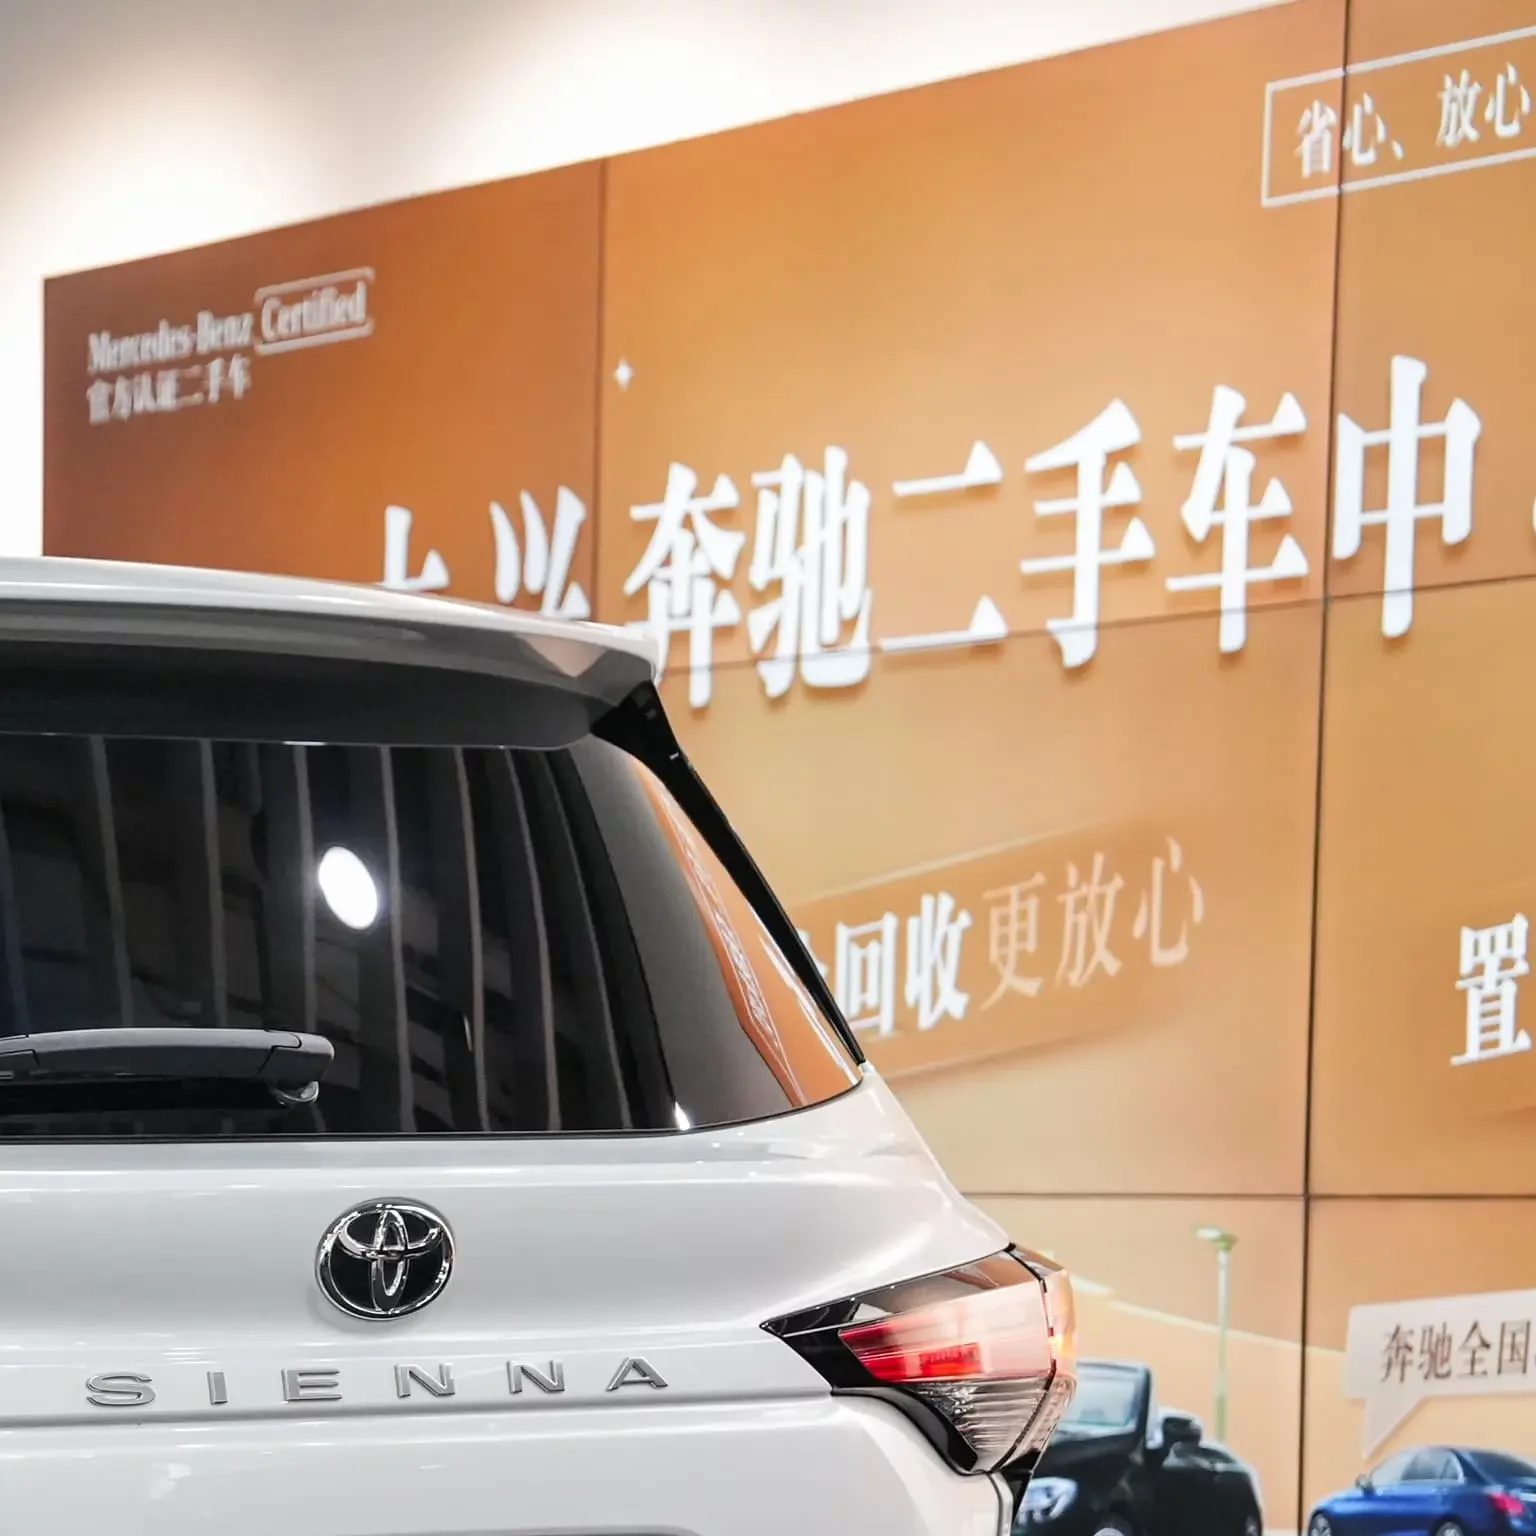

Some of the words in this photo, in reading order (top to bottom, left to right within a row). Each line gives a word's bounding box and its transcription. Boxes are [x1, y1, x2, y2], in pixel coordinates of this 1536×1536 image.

[87, 309, 254, 376] Mercedes-Benz
[260, 279, 368, 343] Certified
[86, 353, 253, 426] 官方认证二手车
[797, 836, 1205, 1037] 回收更放心
[1449, 911, 1533, 1067] 置
[85, 1356, 670, 1407] SIENNA
[1380, 1319, 1532, 1385] 奔驰全国
